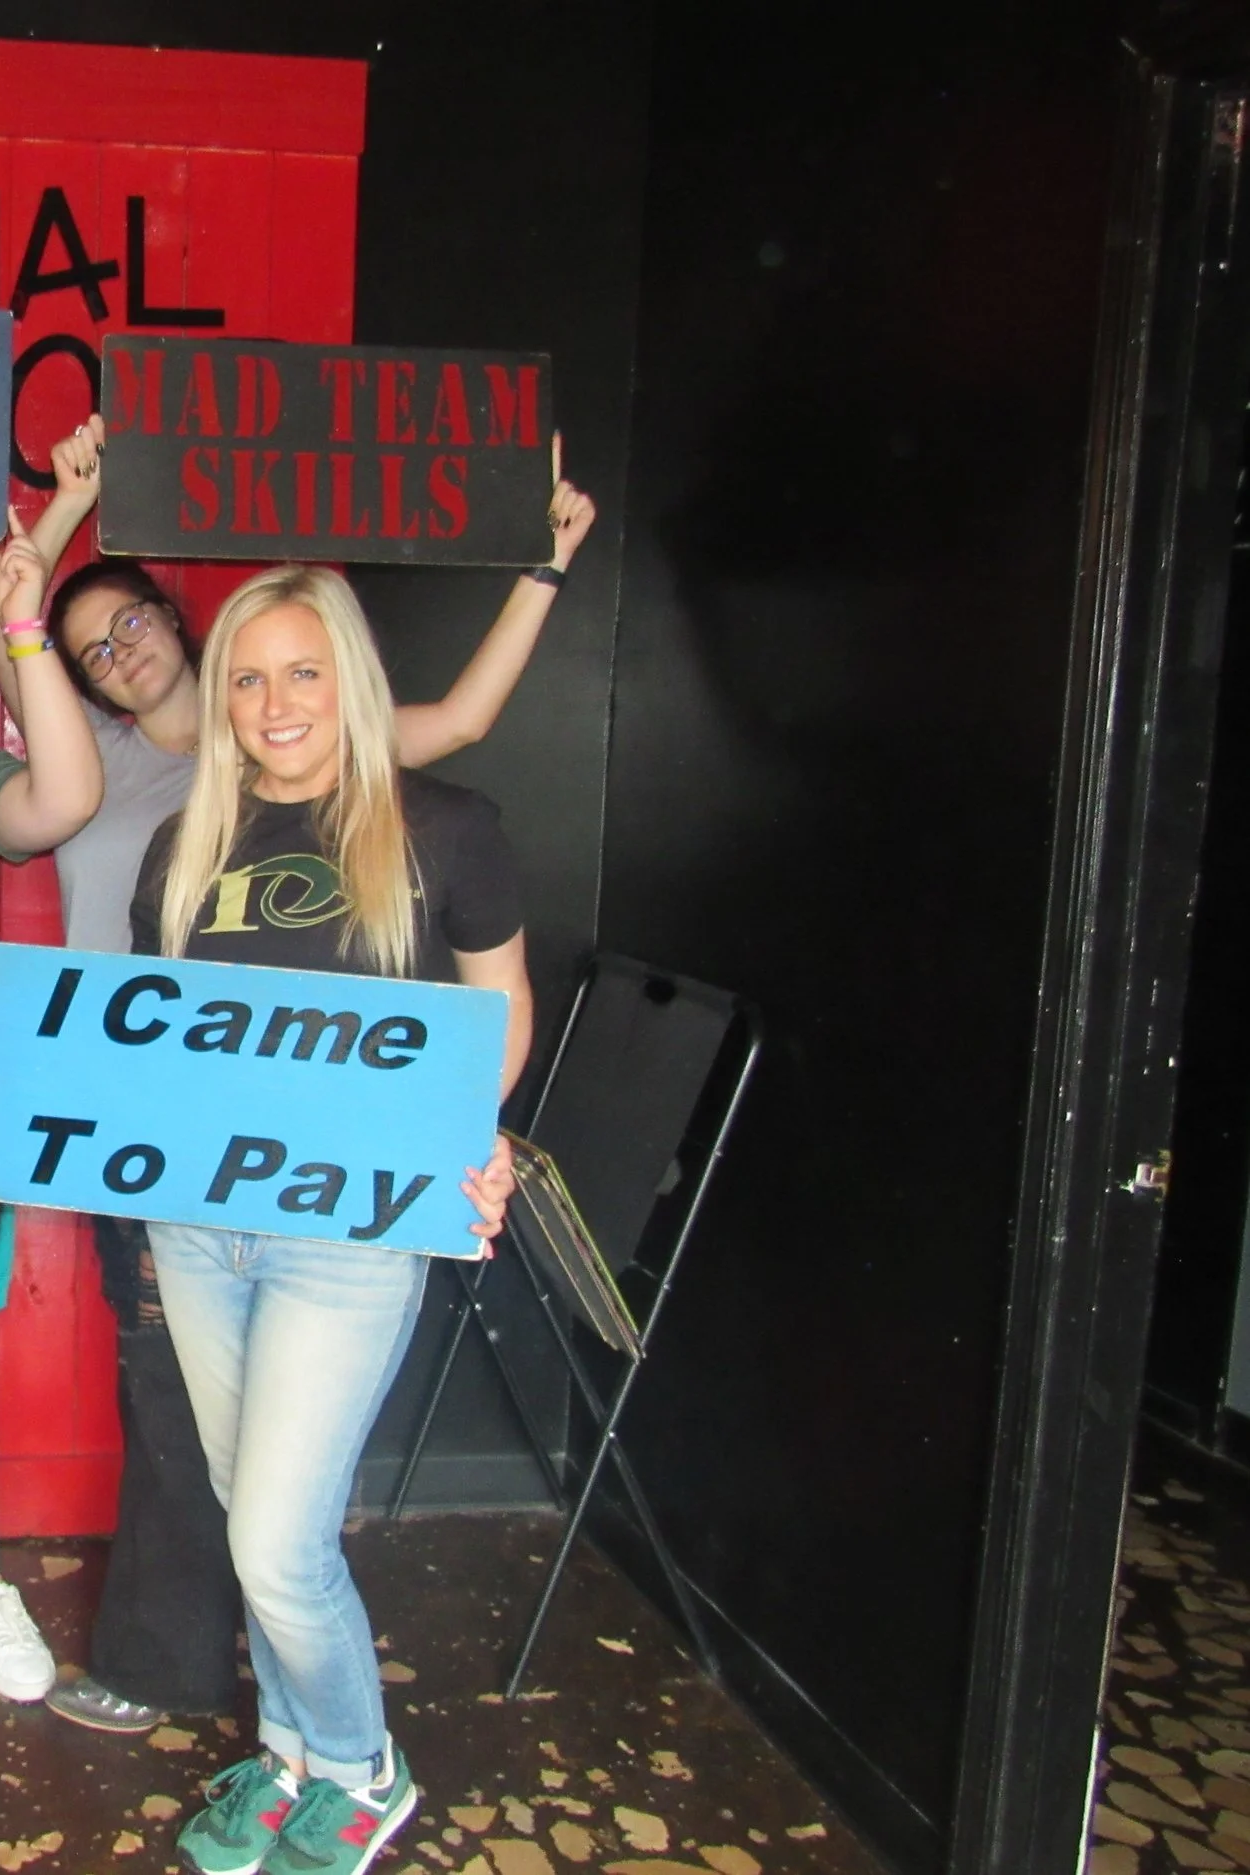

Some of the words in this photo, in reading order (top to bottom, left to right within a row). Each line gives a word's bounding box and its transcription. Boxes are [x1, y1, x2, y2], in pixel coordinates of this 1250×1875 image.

[107, 347, 283, 440] MAD
[319, 357, 540, 449] TEAM
[179, 445, 470, 540] SKILLS
[37, 967, 84, 1038] I
[102, 973, 429, 1070] Came
[28, 1114, 167, 1195] To
[204, 1134, 436, 1241] Pay
